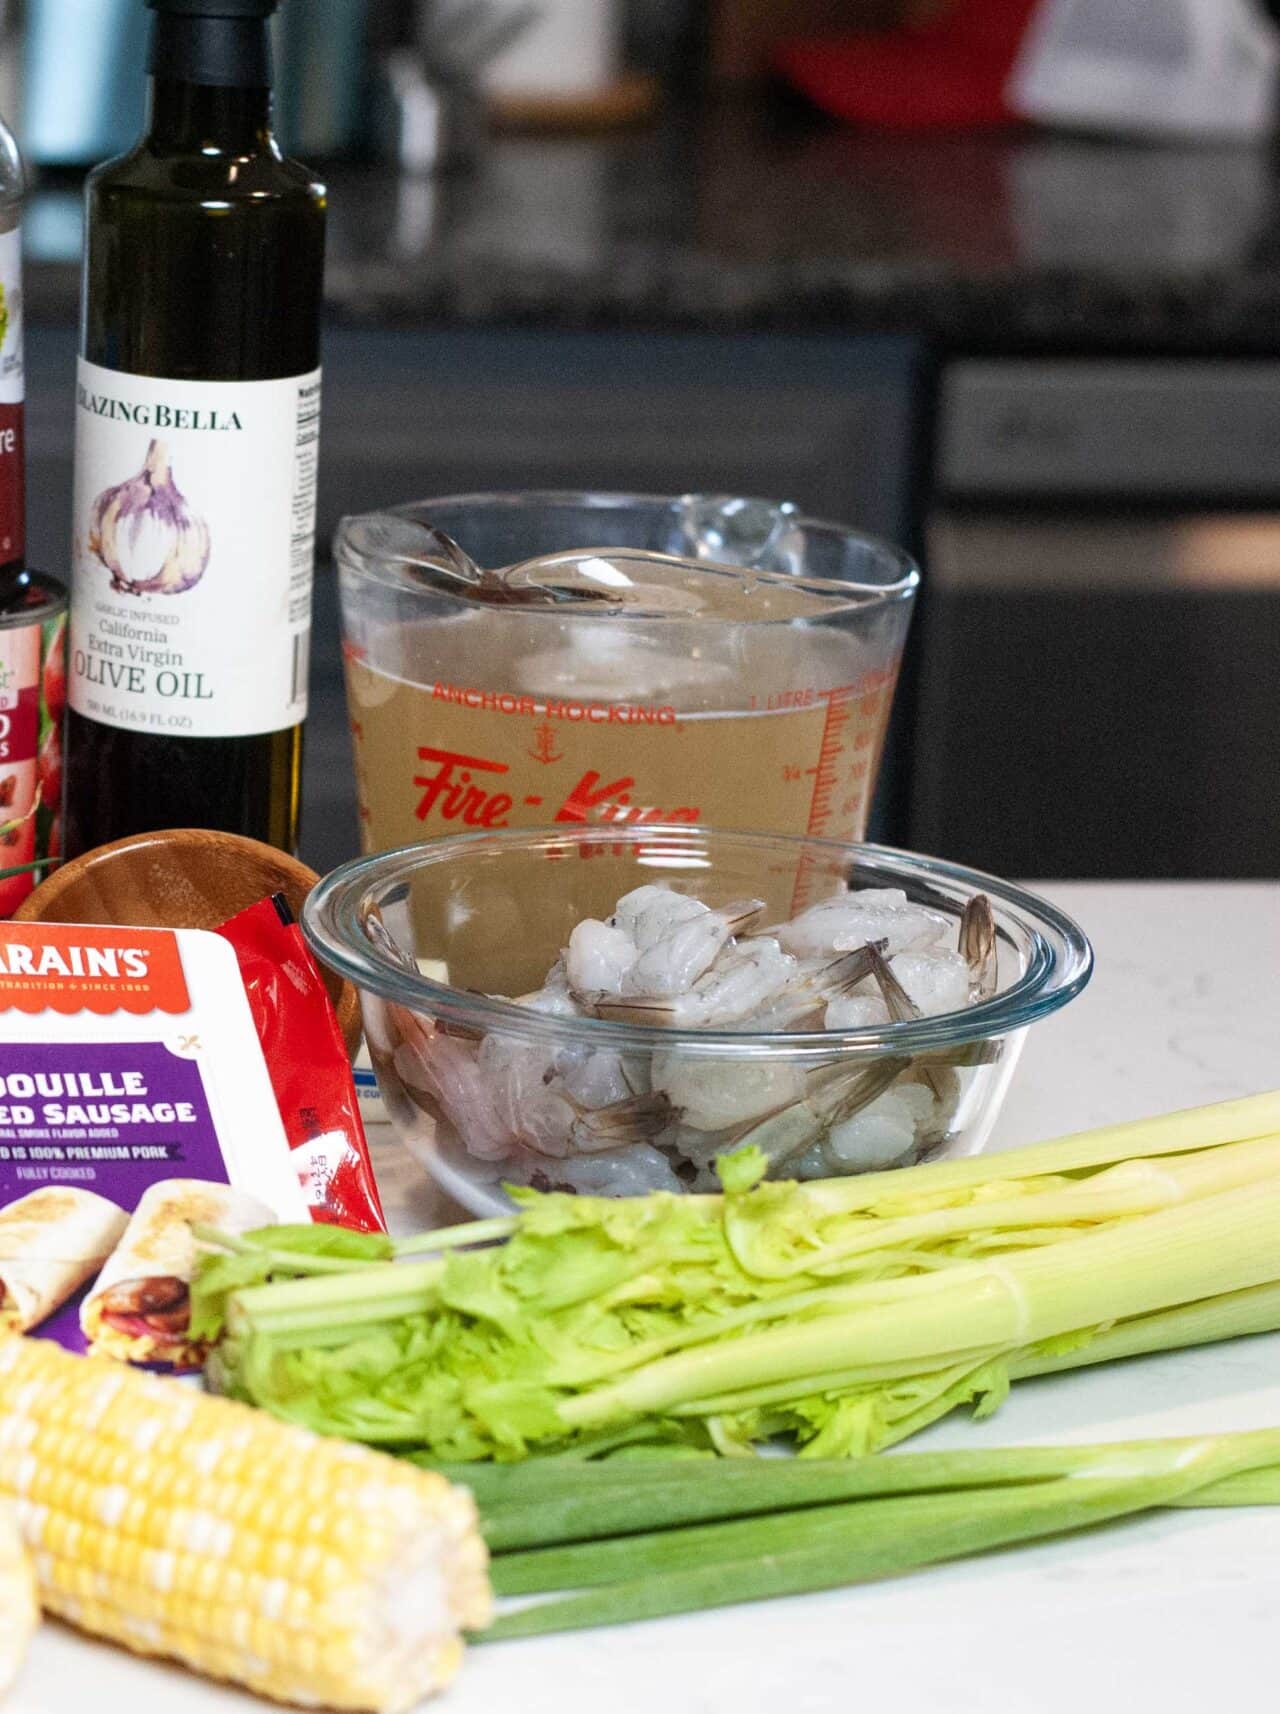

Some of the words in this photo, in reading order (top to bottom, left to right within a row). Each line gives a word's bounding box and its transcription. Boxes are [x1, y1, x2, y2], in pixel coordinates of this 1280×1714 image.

[154, 404, 244, 431] BELLA
[99, 619, 168, 643] California
[88, 634, 124, 658] Extra
[127, 644, 184, 667] Virgin
[75, 650, 145, 694] OLIVE
[156, 671, 214, 699] OIL
[433, 680, 536, 718] ANCHOR
[546, 699, 677, 726] HOCKING
[0, 980, 65, 991] TRADITION
[81, 983, 116, 992] SINCE
[42, 1102, 197, 1125] SAUSAGE
[17, 1127, 51, 1139] SMOKE
[88, 1127, 119, 1139] ADDED
[12, 1146, 27, 1160] IS
[28, 1146, 65, 1160] 100%
[66, 1146, 131, 1160] PREMIUM
[131, 1146, 169, 1160] PORK
[16, 1166, 49, 1180] FULLY
[49, 1166, 97, 1180] COOKED
